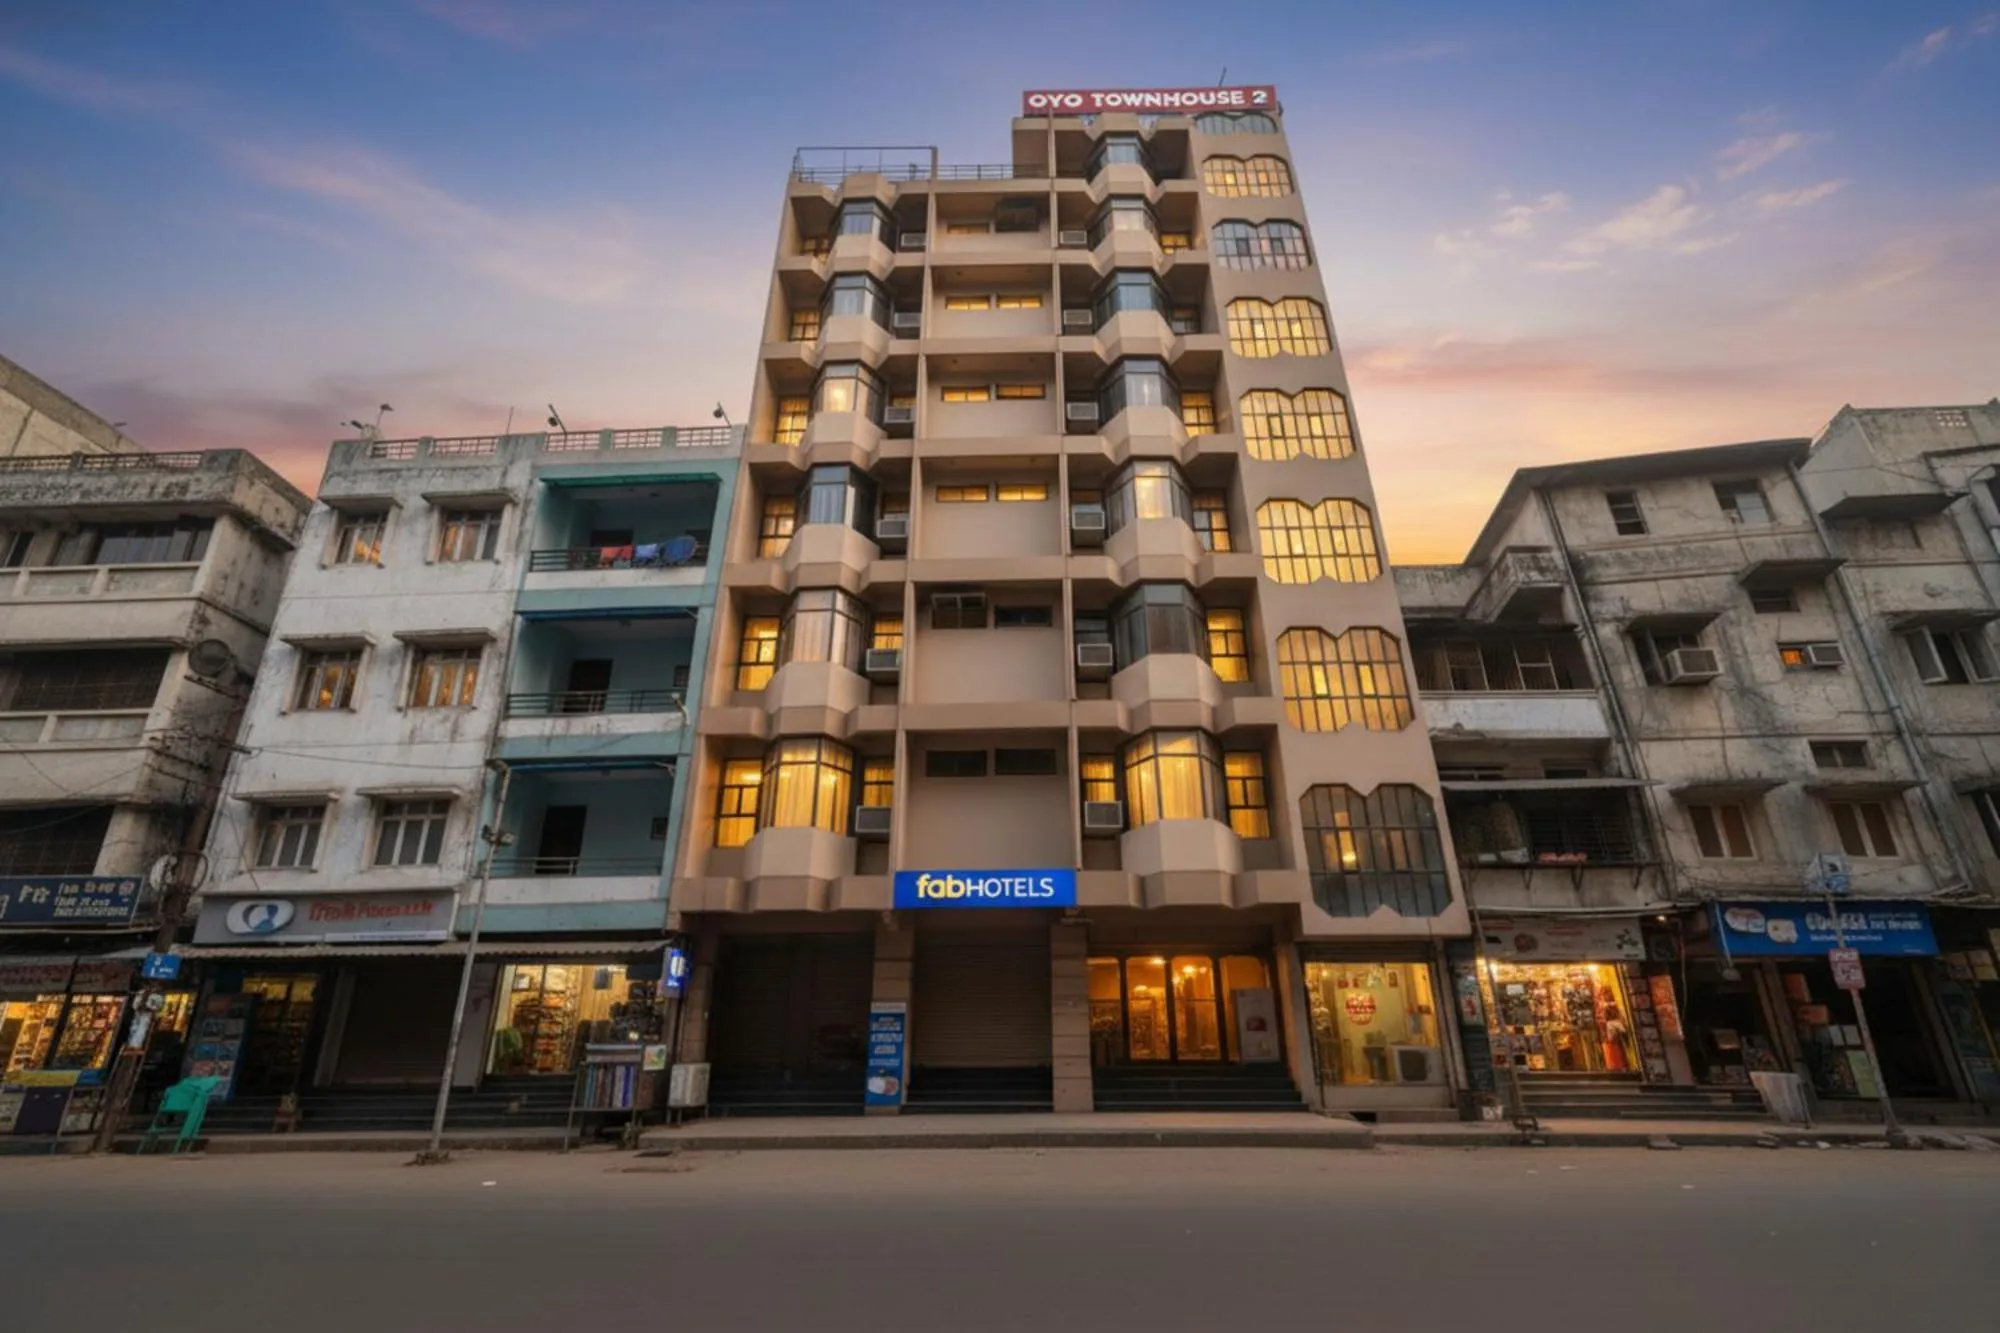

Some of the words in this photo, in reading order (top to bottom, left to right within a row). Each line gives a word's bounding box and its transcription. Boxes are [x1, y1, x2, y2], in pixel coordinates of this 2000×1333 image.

[1028, 93, 1084, 108] OYO
[1090, 90, 1245, 107] TOWNHOUSE
[1252, 90, 1268, 105] 2
[916, 873, 1055, 898] fabHOTELS
